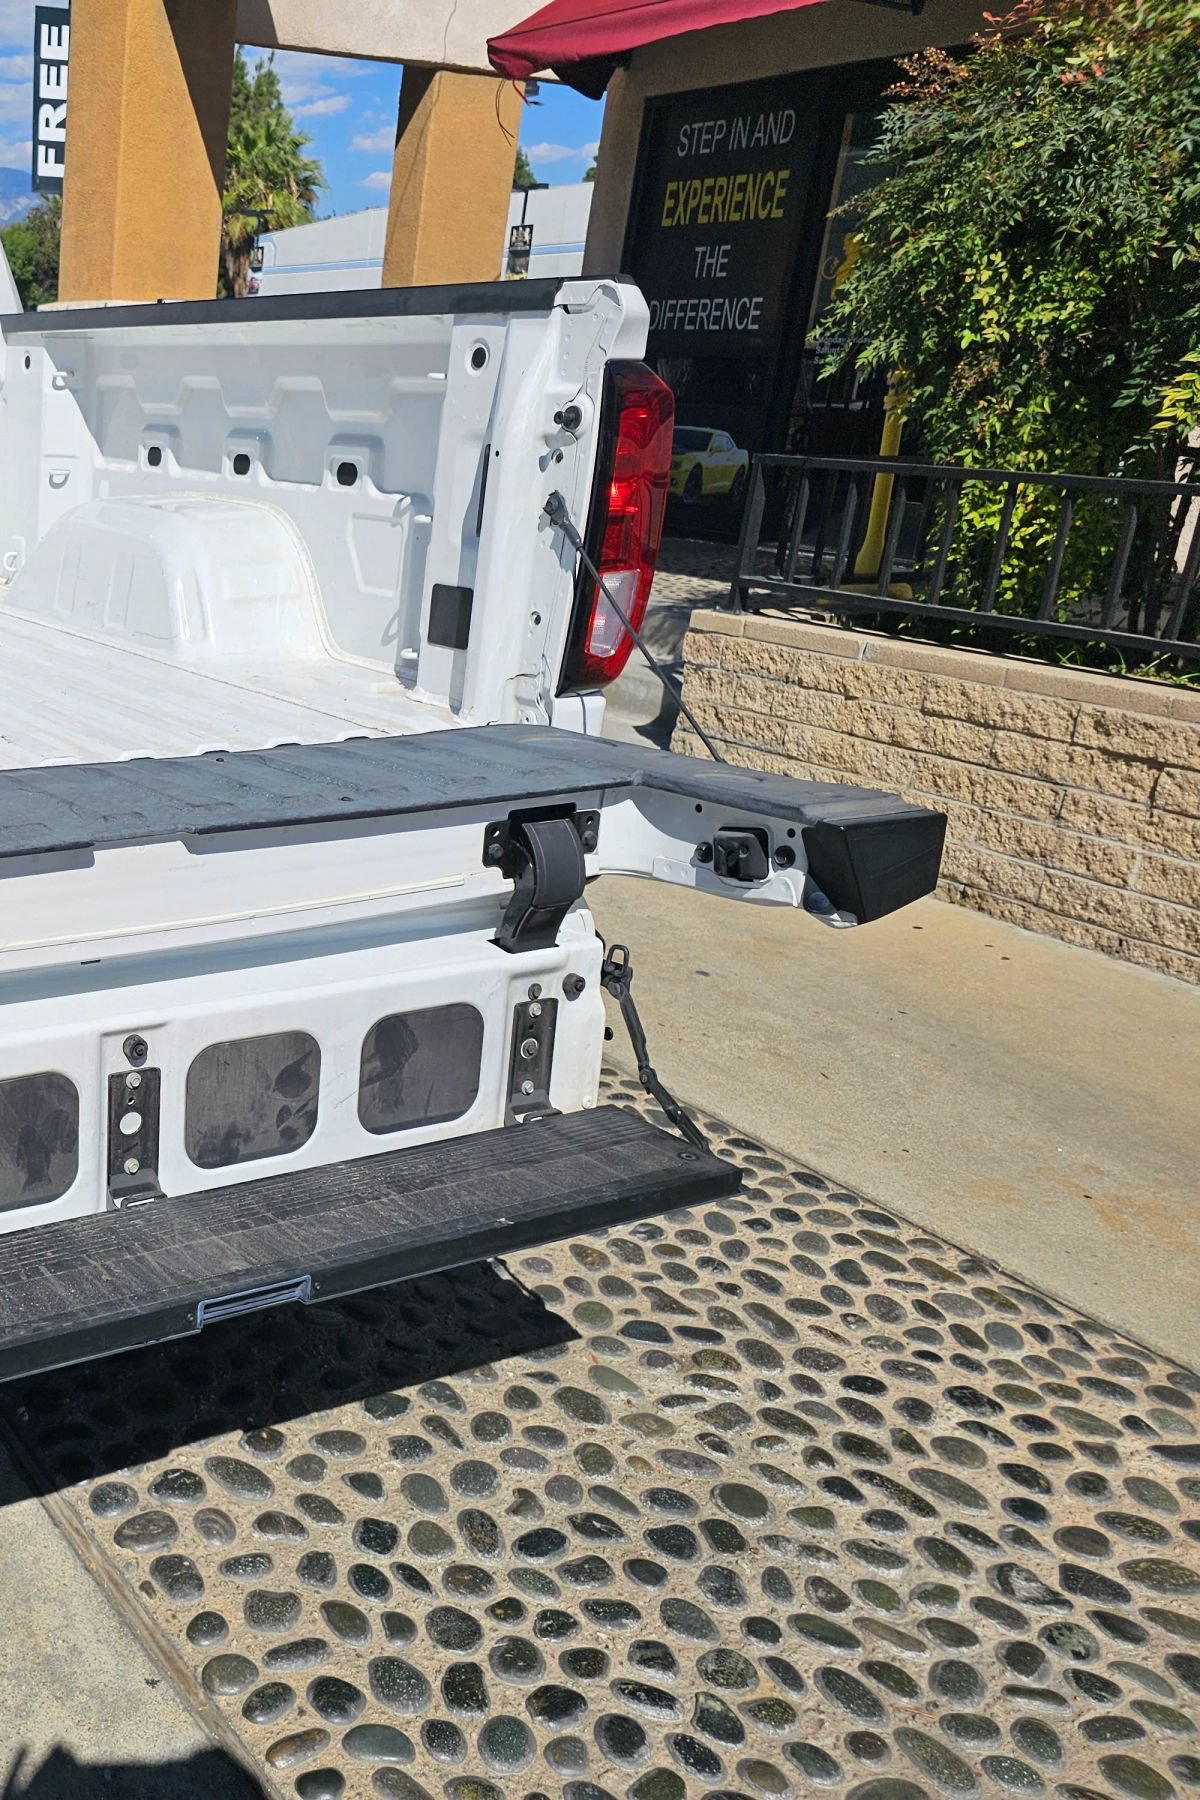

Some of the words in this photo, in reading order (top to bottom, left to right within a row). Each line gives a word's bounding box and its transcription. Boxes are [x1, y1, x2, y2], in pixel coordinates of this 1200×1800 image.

[37, 23, 70, 178] FREE
[677, 119, 727, 157] STEP
[728, 116, 751, 151] IN
[750, 109, 796, 148] AND
[660, 169, 791, 228] EXPERIENCE
[694, 244, 732, 279] THE
[649, 296, 764, 331] DIFFERENCE
